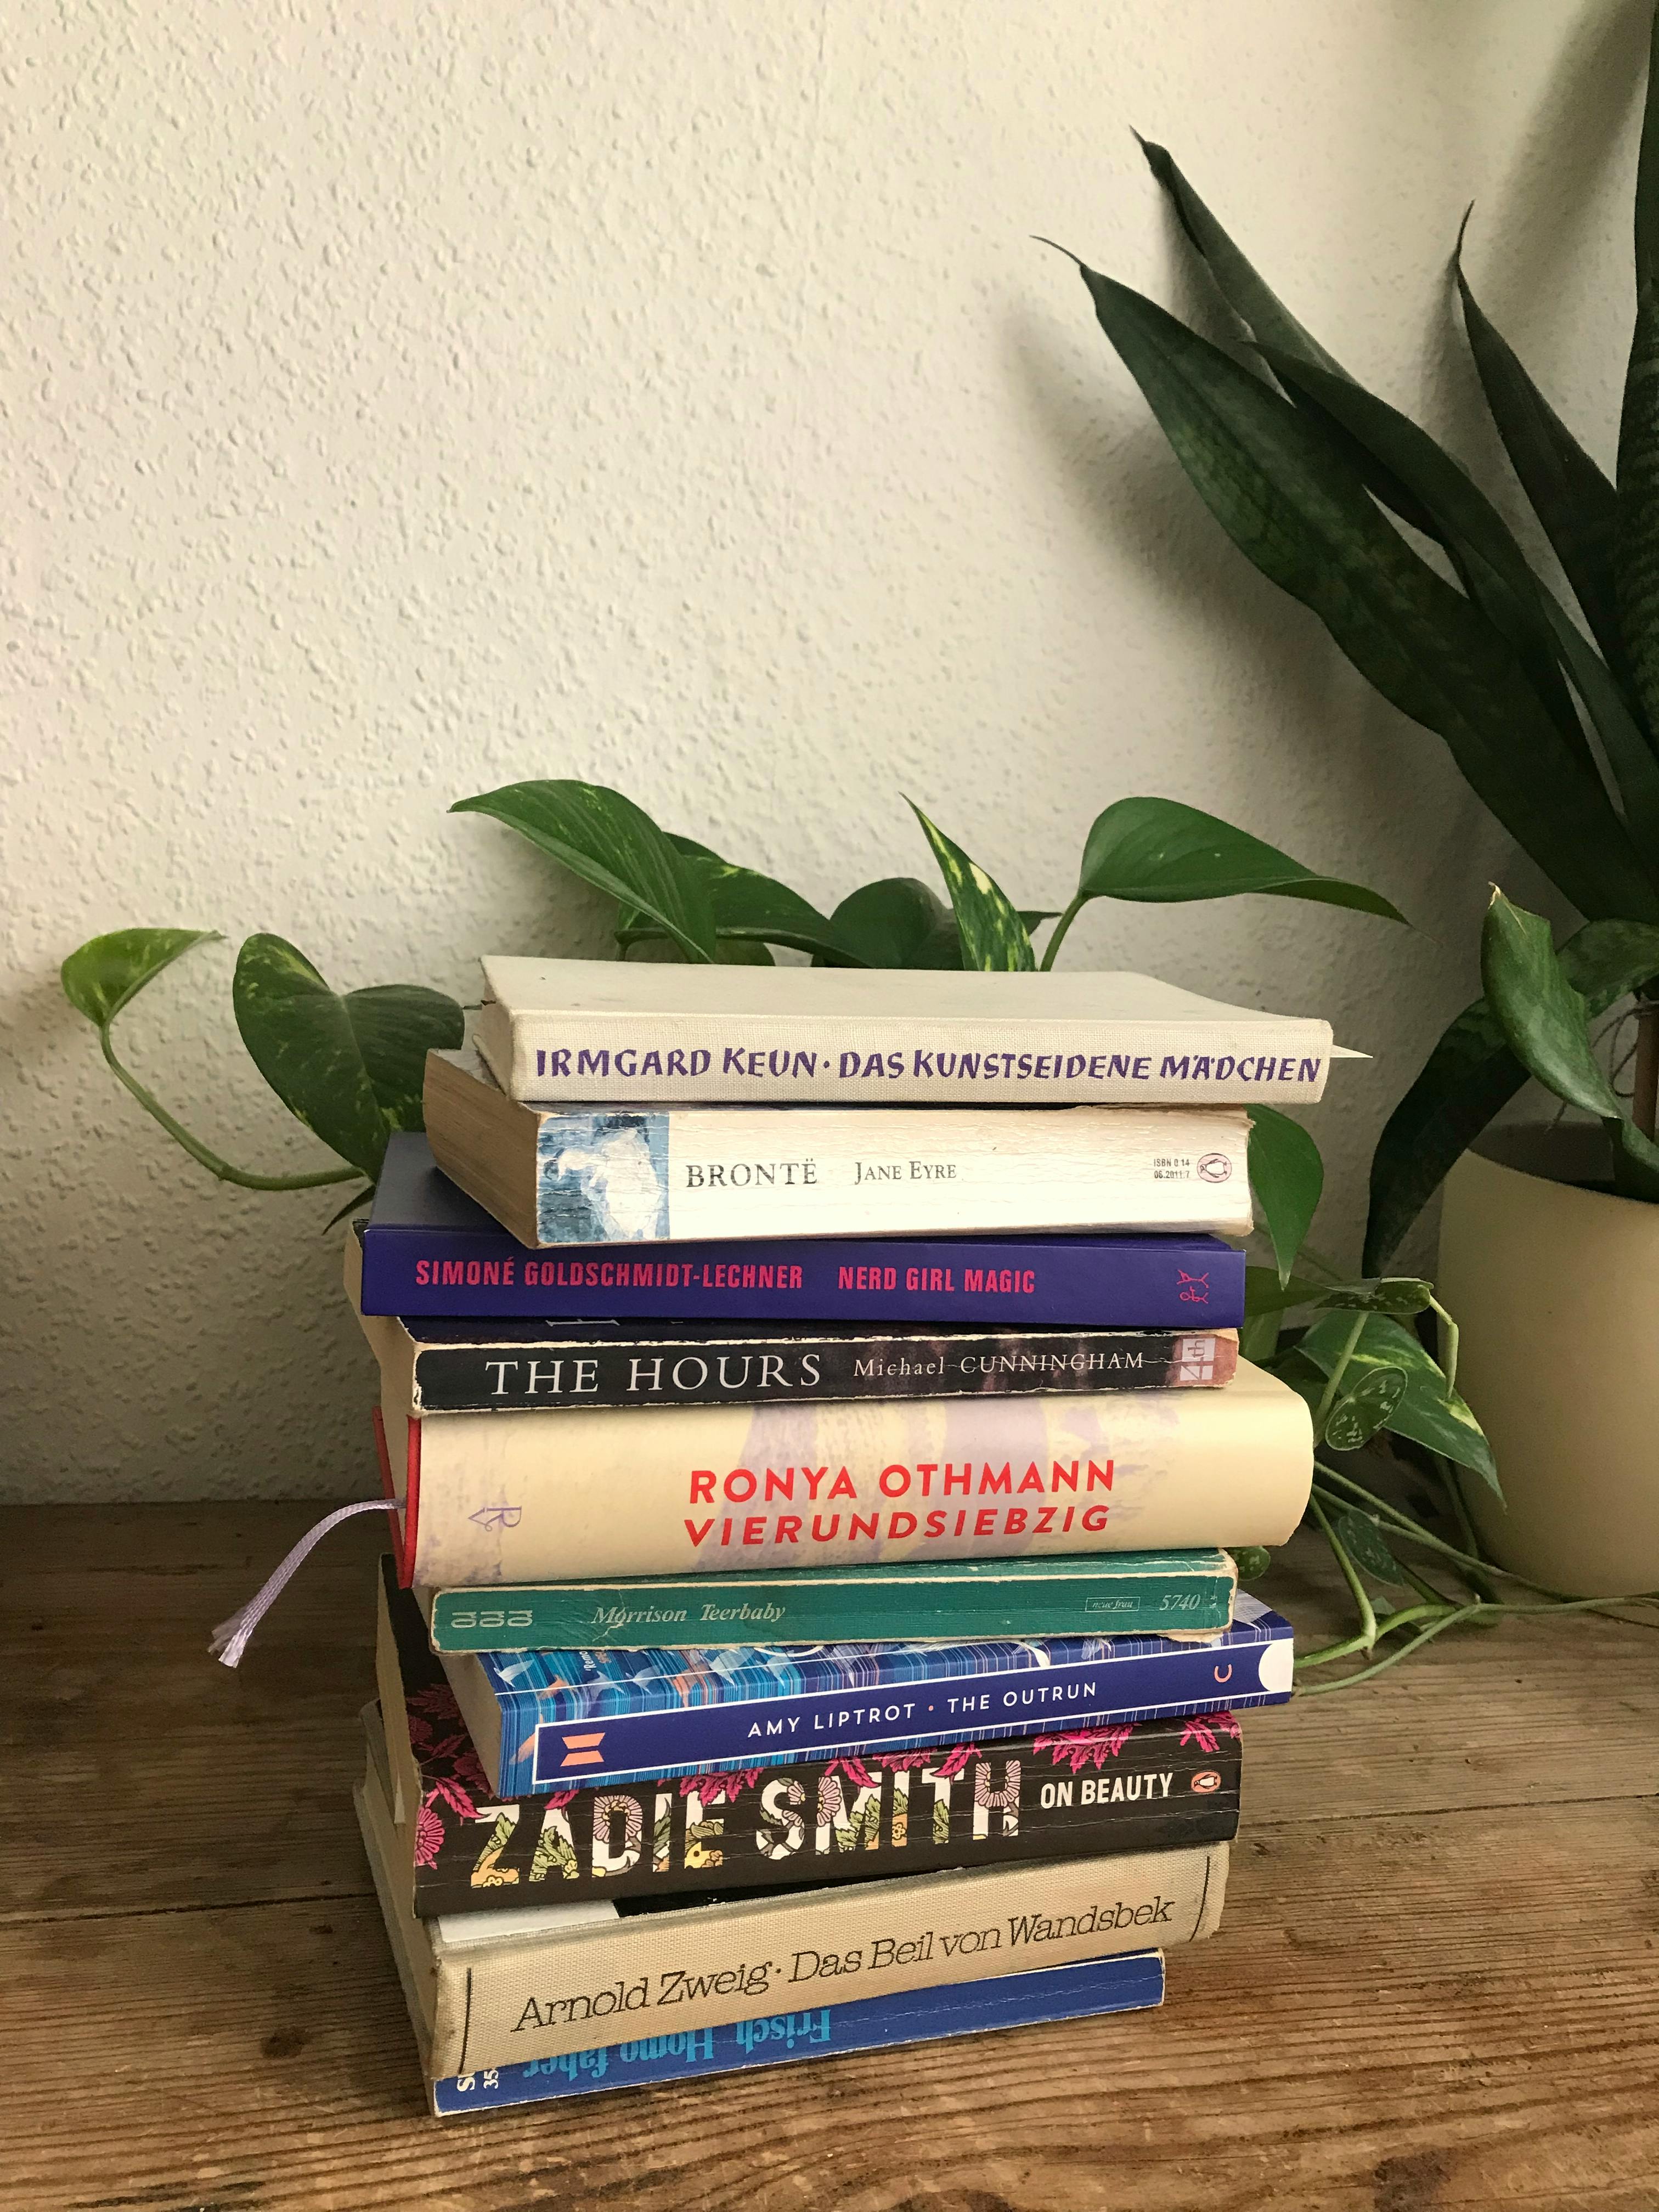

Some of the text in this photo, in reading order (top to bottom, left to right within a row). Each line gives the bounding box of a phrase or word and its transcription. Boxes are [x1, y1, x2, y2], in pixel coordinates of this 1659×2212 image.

[537, 1048, 712, 1077] IRMGARD
[839, 1051, 905, 1079] DAS
[913, 1049, 1152, 1080] KUNSTSEIDENE
[1159, 1055, 1322, 1082] MÄDCHEN
[685, 1158, 818, 1187] BRONTË
[1154, 1158, 1172, 1167] ISBN
[416, 1256, 803, 1289] SIMONÉ GOLDSCHMIDT-LECHNER
[838, 1266, 1036, 1294] NERD GIRL MAGIC
[486, 1353, 821, 1395] THE HOURS
[854, 1352, 1144, 1376] Michael CUNNINGHAM
[690, 1460, 1114, 1504] RONYA OTHMANN
[684, 1504, 1109, 1548] VIERUNDSIEBZIG
[590, 1602, 786, 1623] Morrison Teerbaby
[1159, 1594, 1201, 1611] 5740
[748, 1682, 1097, 1738] AMY LIPTROT THE OUTRUN
[1041, 1773, 1173, 1809] ON BEAUTY
[471, 1760, 1021, 1889] ZADIE SMITH
[511, 1978, 650, 2033] Arnold
[788, 1950, 861, 1982] Das
[868, 1932, 934, 1970] Beil
[940, 1928, 1000, 1957] von
[1008, 1896, 1176, 1948] Wandsbek
[619, 2028, 714, 2063] Homo
[736, 2009, 832, 2054] Frisch
